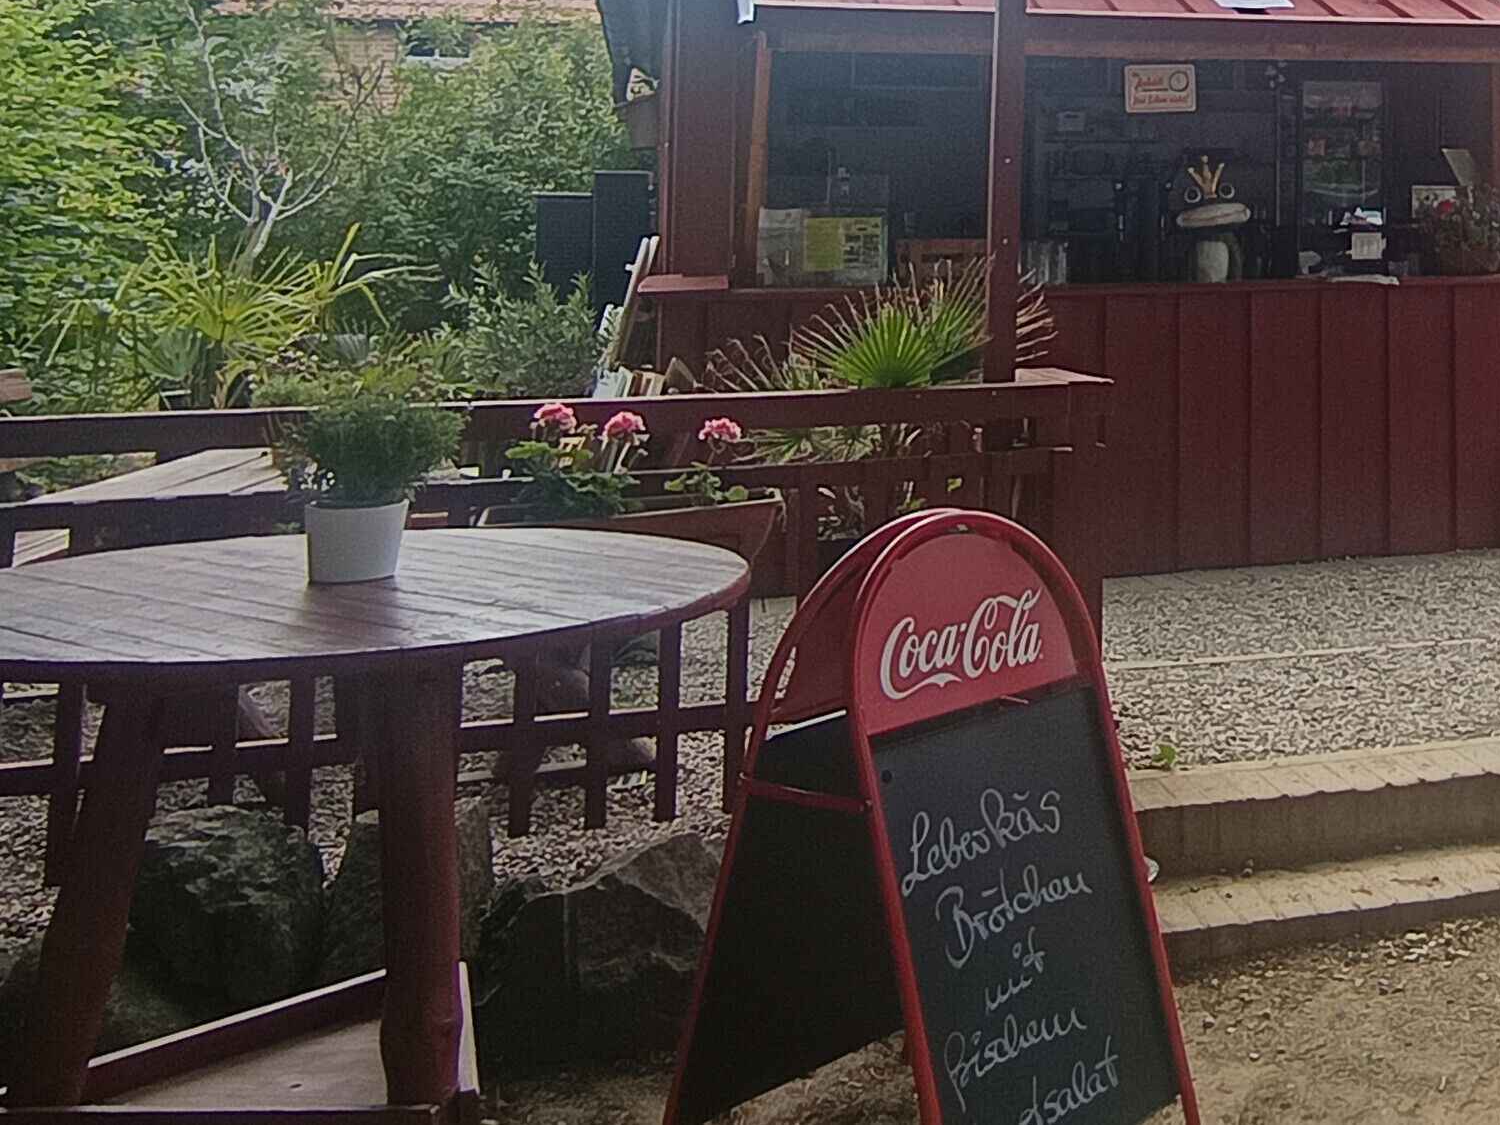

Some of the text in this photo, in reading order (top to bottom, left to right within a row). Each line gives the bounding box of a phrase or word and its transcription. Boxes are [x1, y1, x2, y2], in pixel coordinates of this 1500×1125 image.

[880, 588, 1043, 700] Coca-Cola
[936, 867, 1092, 969] Brötchen
[985, 926, 1045, 1016] mit
